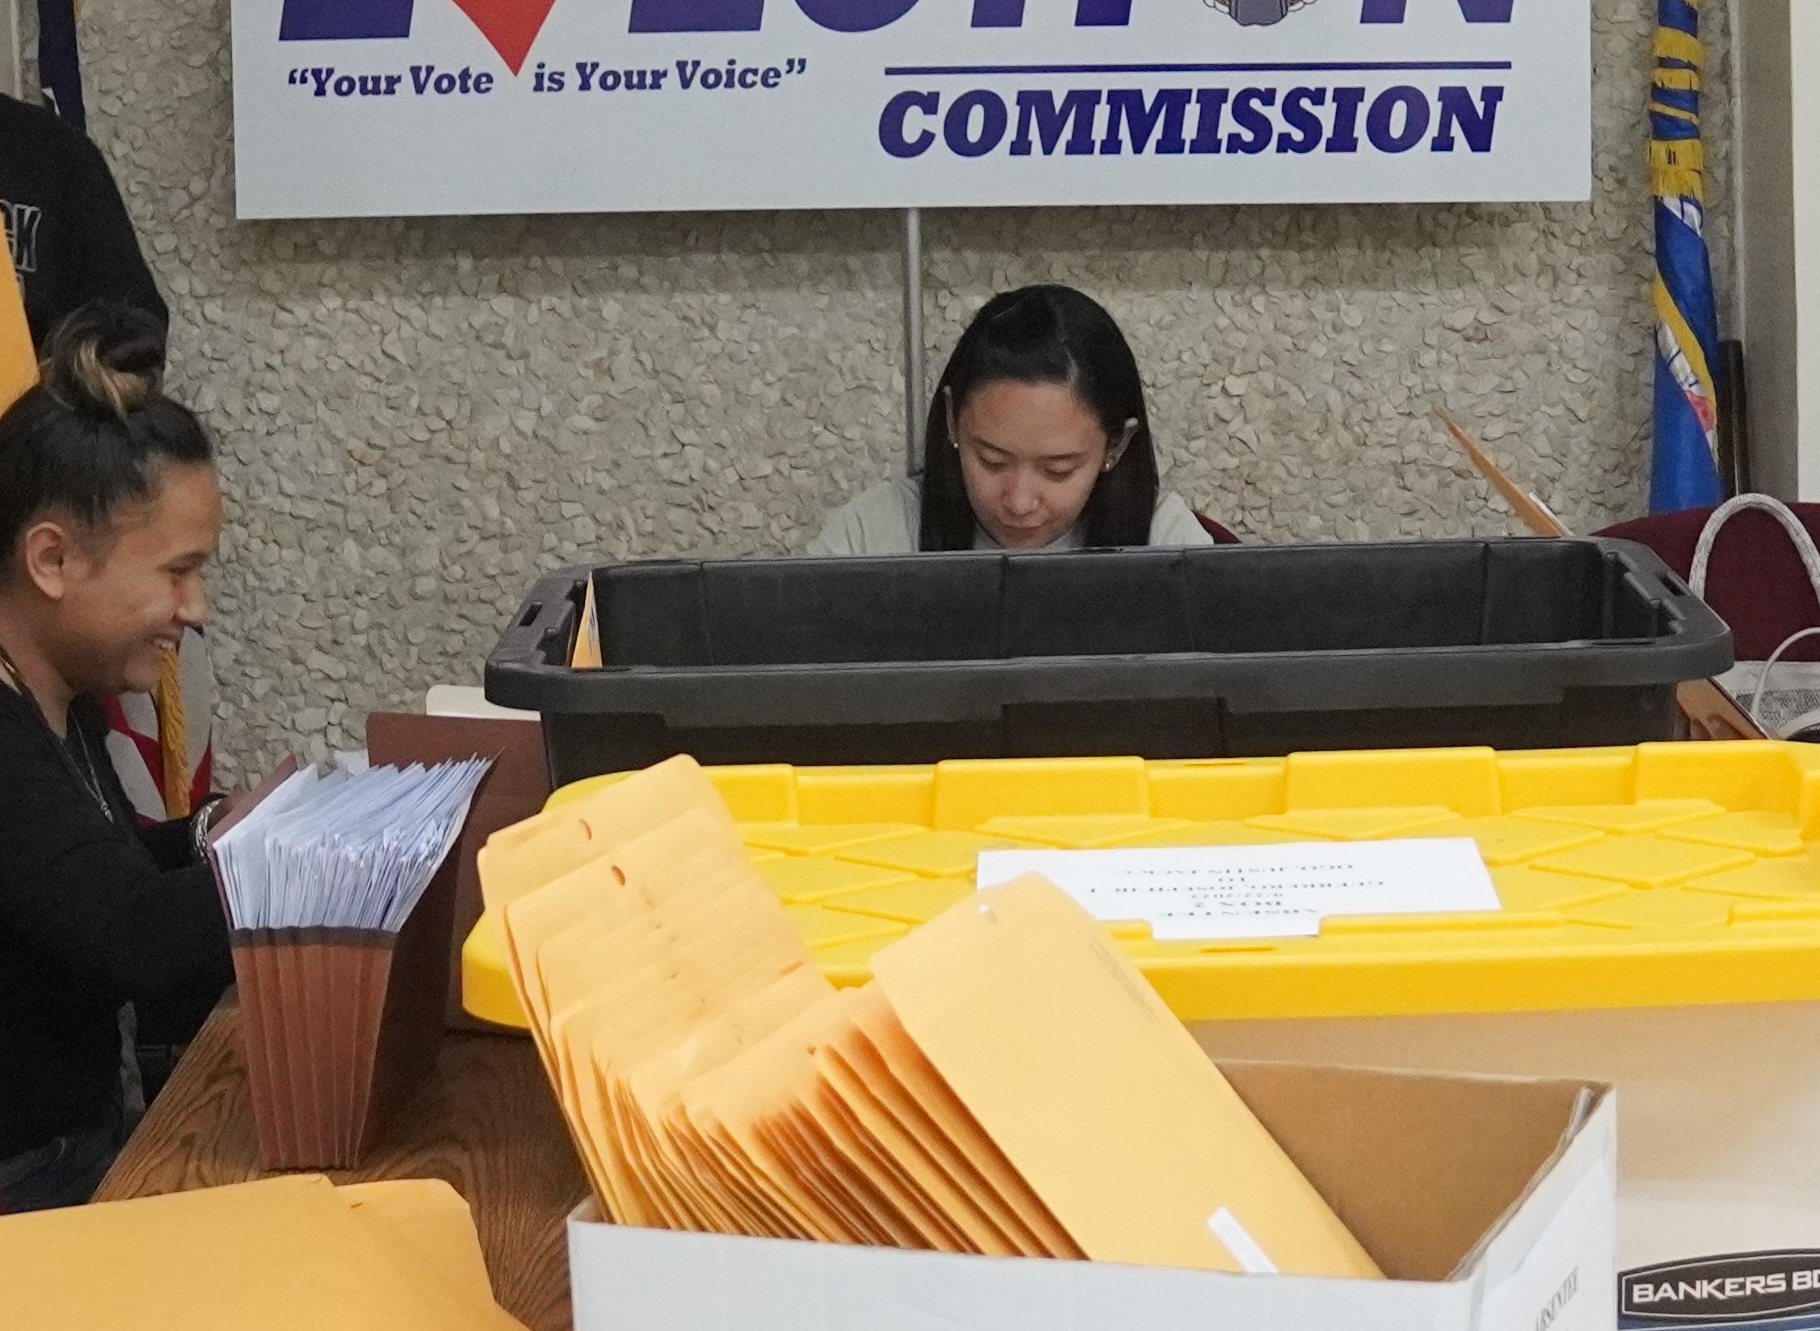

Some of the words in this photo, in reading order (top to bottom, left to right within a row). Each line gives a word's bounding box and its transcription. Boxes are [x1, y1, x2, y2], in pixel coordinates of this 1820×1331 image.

[409, 64, 495, 95] Vote
[532, 62, 566, 92] is
[574, 61, 669, 91] Your
[877, 86, 1504, 159] COMMISSION
[1631, 1272, 1787, 1304] BANKERS
